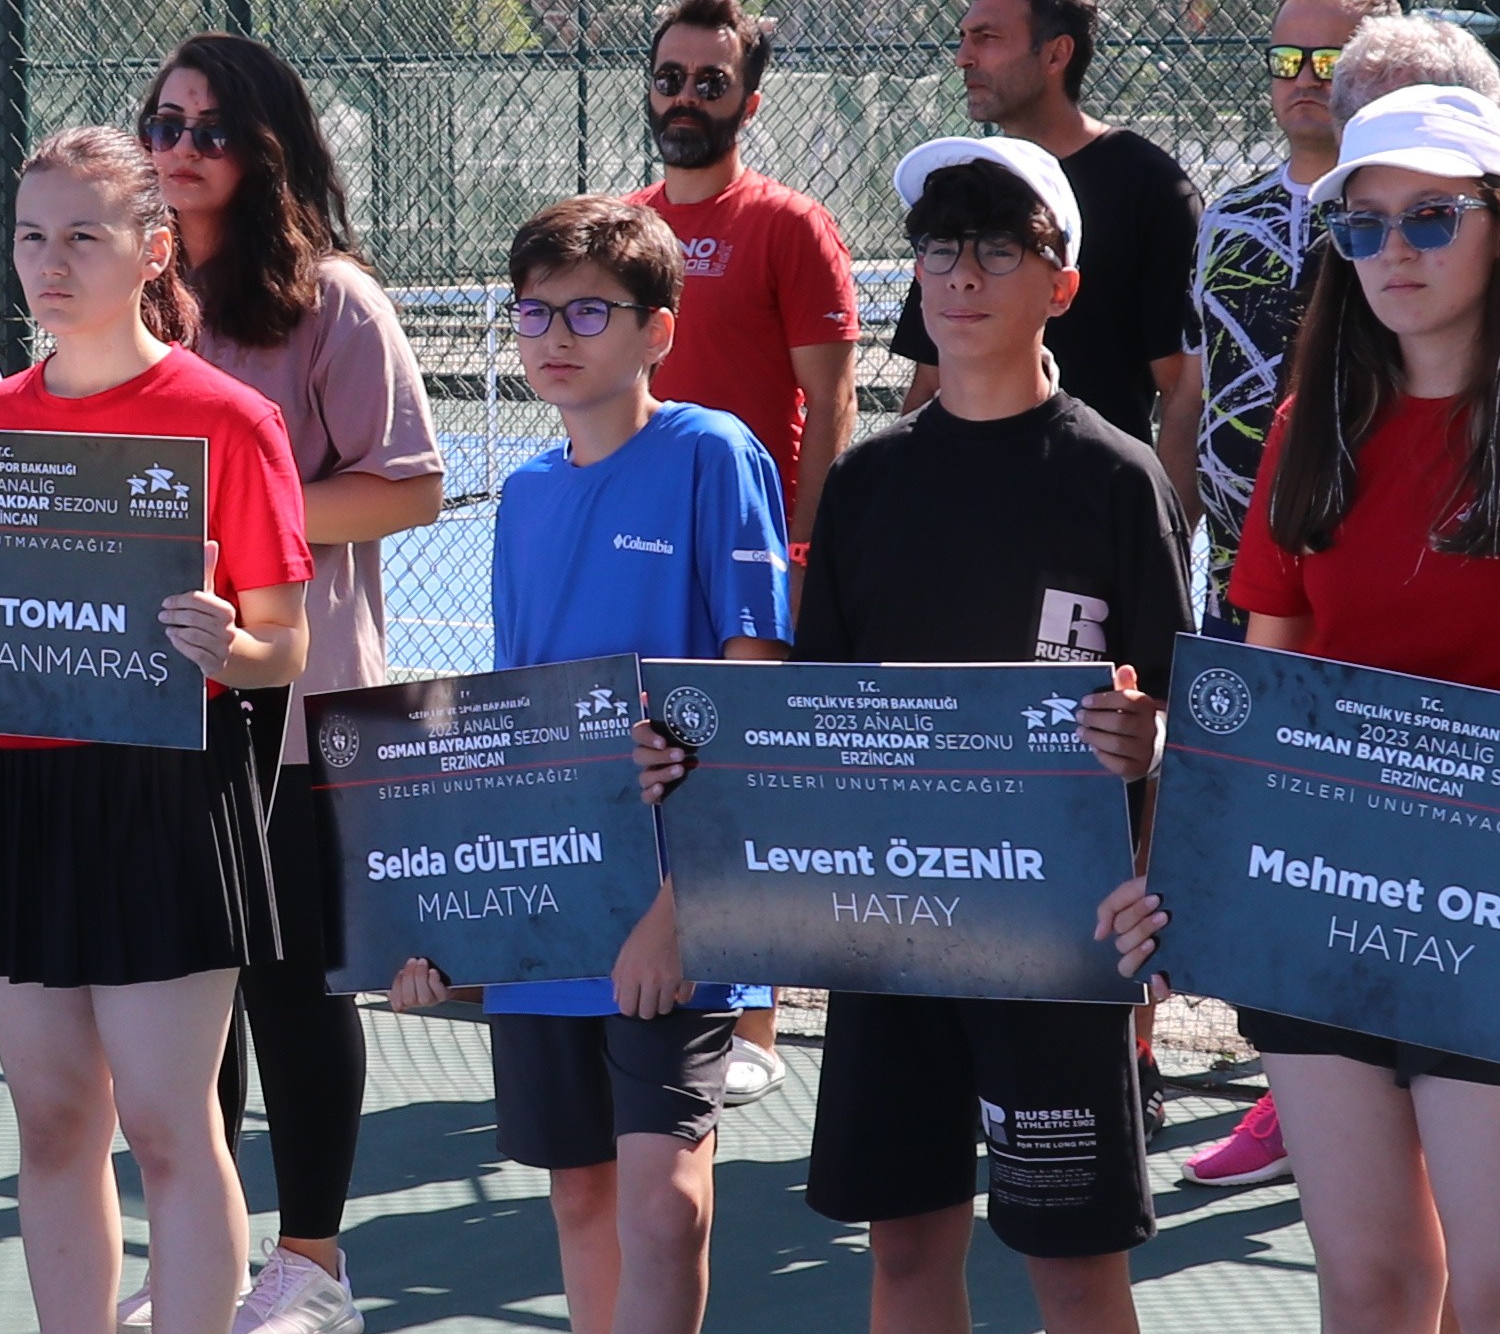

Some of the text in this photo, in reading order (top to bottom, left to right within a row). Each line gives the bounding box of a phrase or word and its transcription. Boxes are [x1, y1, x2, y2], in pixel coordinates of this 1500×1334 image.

[54, 497, 118, 513] SEZONU
[130, 499, 189, 511] ANADOLU
[623, 534, 674, 554] Columbia
[0, 598, 126, 633] TOMAN
[857, 680, 879, 693] T.C.
[787, 694, 958, 710] GENÇLİK SPOR BAKANLIĞI
[1421, 696, 1443, 713] T.C.
[428, 714, 514, 738] 2023 ANALİG
[579, 718, 629, 732] ANADOLU
[814, 712, 933, 732] 2023 ANALİG
[1335, 699, 1395, 722] GENÇLİK
[1414, 713, 1450, 731] SPOR
[378, 726, 570, 760] OSMAN BAYRAKDAR SEZONU
[745, 730, 1013, 750] OSMAN BAYRAKDAR SEZONU
[1360, 724, 1494, 764] 2023 ANALİG
[440, 751, 505, 772] ERZİNCAN
[841, 748, 915, 766] ERZİNCAN
[1276, 727, 1351, 756] OSMAN
[1356, 742, 1485, 782] BAYRAKDAR
[378, 769, 578, 800] SİZLERİ UNUTMAYACAĞIZ!
[747, 772, 1025, 793] SİZLERİ UNUTMAYACAĞIZ!
[1267, 773, 1354, 804] SİZLERİ
[1380, 766, 1464, 798] ERZİNCAN
[368, 827, 602, 881] Selda GÜLTEKİN
[745, 838, 1045, 880] Levent ÖZENİR
[1248, 844, 1424, 913] Mehmet
[418, 883, 559, 922] MALATYA
[831, 891, 960, 927] HATAY
[1328, 915, 1475, 975] HATAY
[1014, 1109, 1095, 1121] RUSSELL
[1016, 1119, 1095, 1129] ATHLETIC 1902
